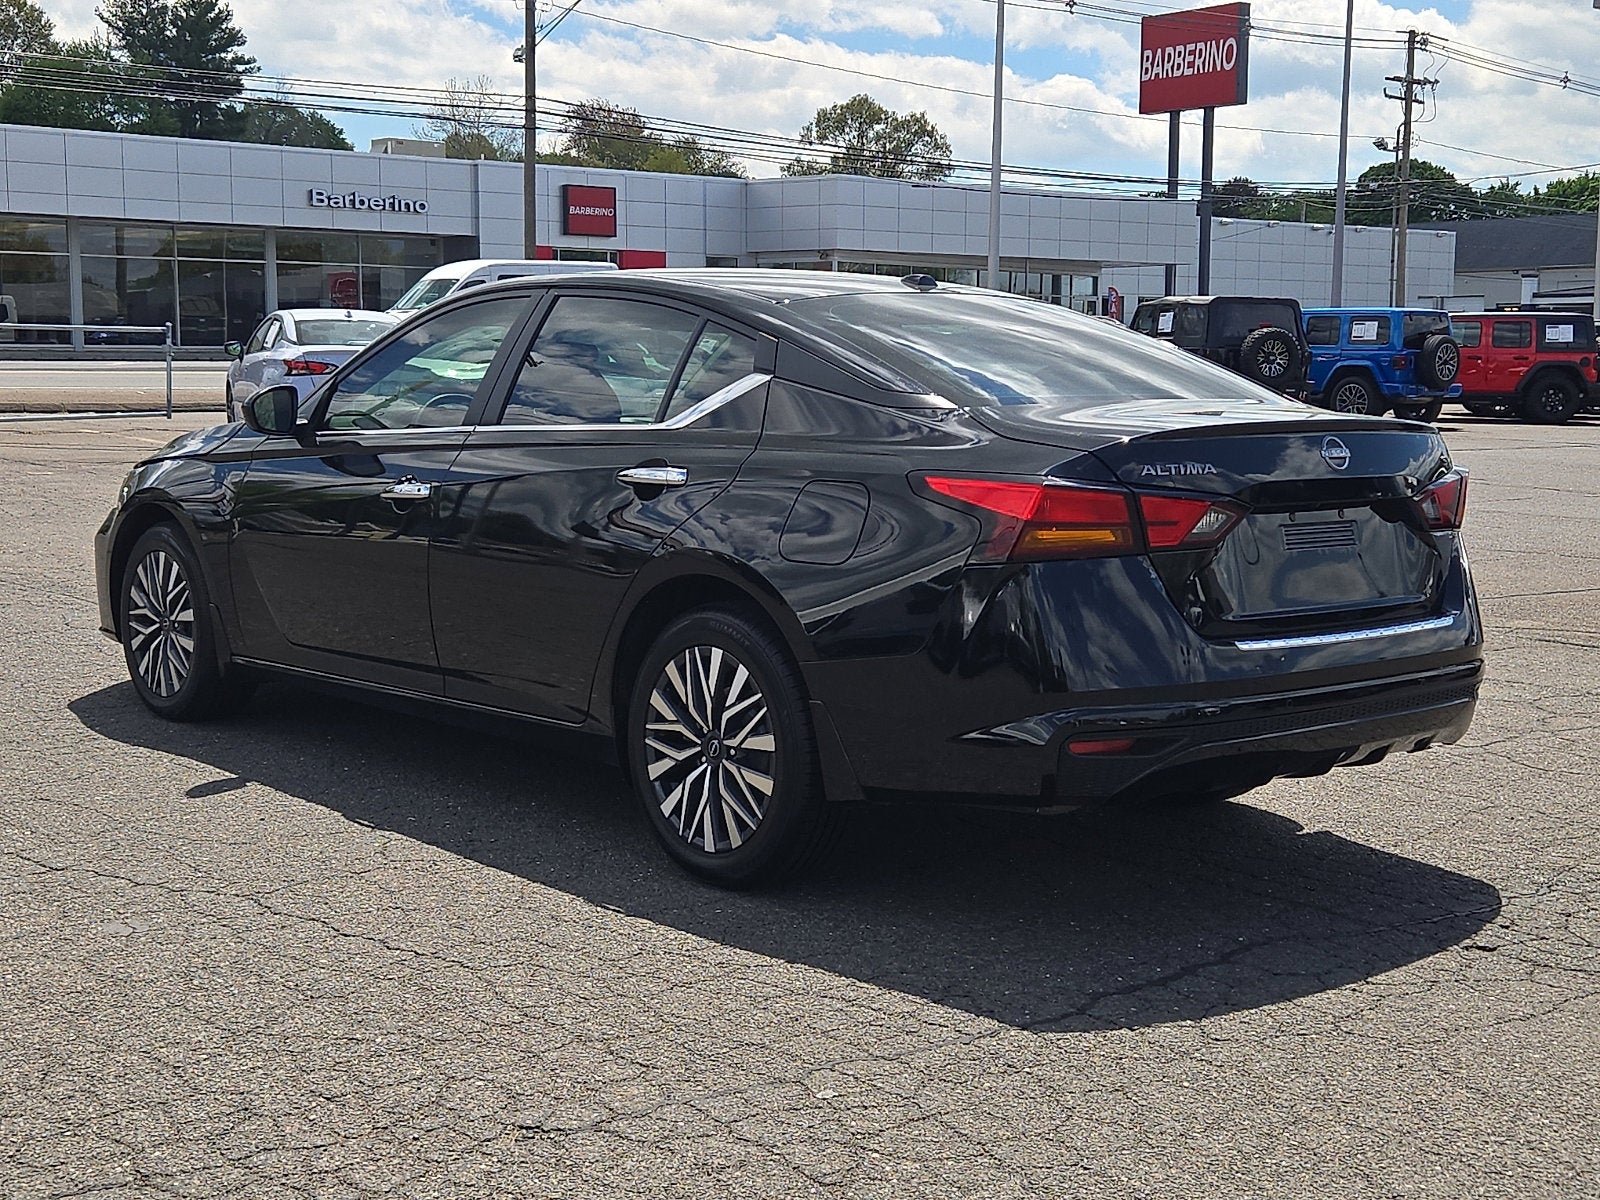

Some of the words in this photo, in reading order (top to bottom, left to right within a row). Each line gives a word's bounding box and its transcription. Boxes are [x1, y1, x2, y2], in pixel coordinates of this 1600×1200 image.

[1141, 37, 1238, 82] BARBERINO
[309, 188, 430, 213] Barberino
[569, 205, 615, 217] BARBERINO
[1140, 463, 1218, 476] ALTIMA
